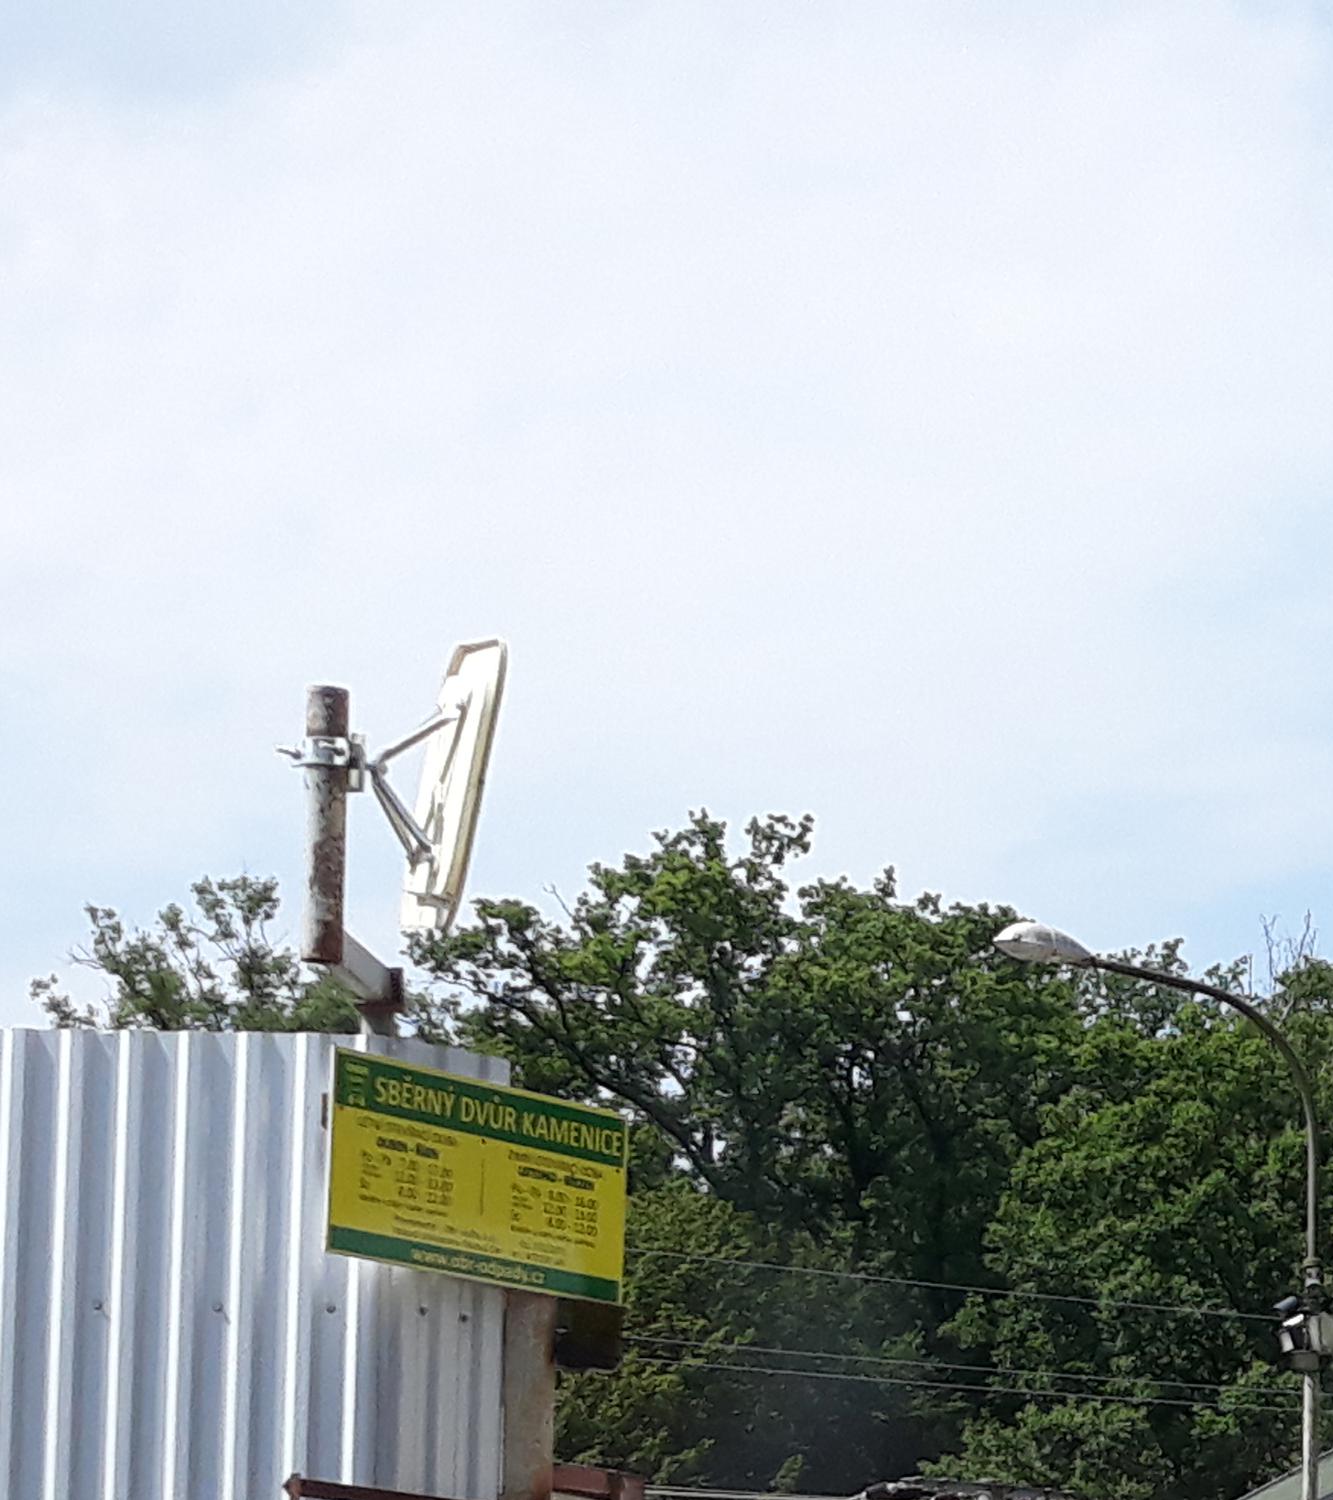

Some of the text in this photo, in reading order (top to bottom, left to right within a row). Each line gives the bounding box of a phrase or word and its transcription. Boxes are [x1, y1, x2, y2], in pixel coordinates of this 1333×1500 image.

[374, 1075, 455, 1118] SBĚRNÝ
[460, 1094, 516, 1133] DVŮR
[522, 1111, 622, 1157] KAMENICE
